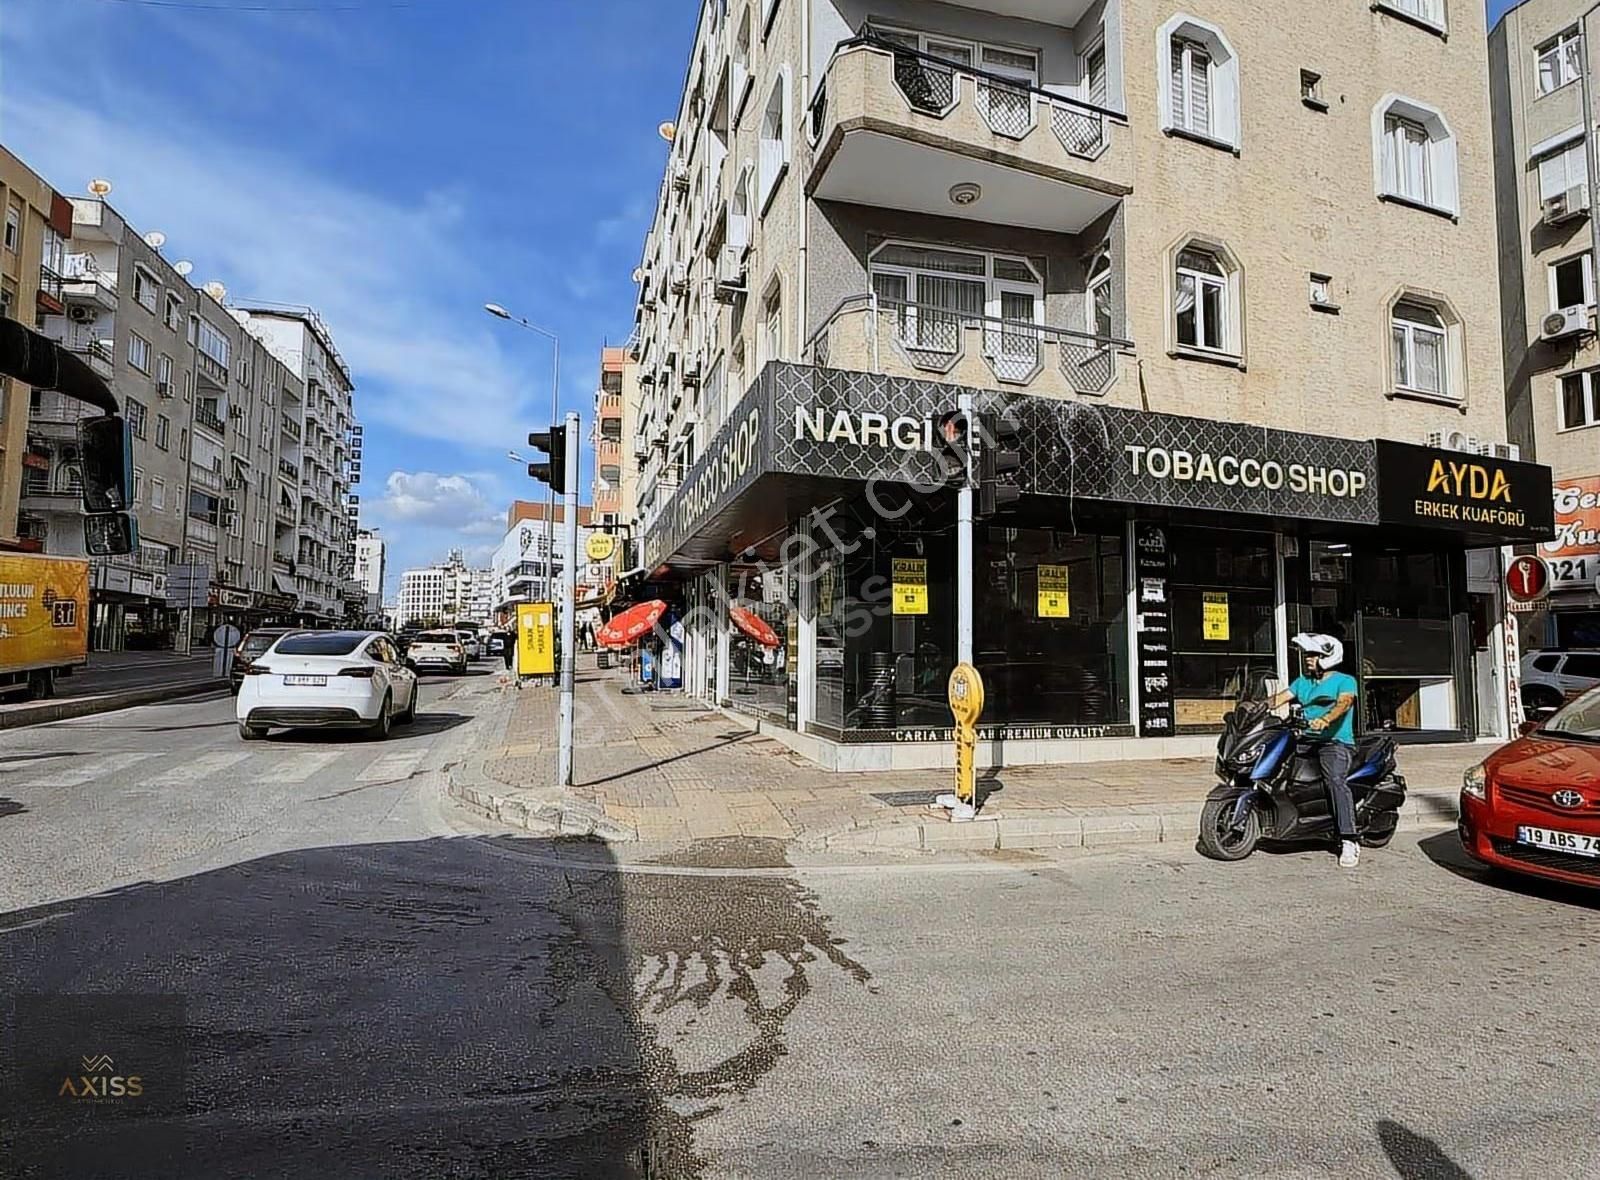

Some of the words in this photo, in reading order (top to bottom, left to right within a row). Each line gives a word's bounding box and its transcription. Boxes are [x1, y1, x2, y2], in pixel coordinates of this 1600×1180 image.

[795, 404, 981, 457] NARGİE
[720, 407, 760, 493] SHOP
[1124, 444, 1284, 490] TOBACCO
[1288, 463, 1367, 498] SHOP
[1427, 459, 1512, 503] AYDA
[1415, 499, 1459, 520] ERKEK
[1462, 505, 1526, 527] KUAFÖRÜ
[1544, 519, 1600, 552] Ku
[0, 584, 34, 598] LULUK
[1527, 828, 1543, 843] 19
[1549, 832, 1576, 849] ABS
